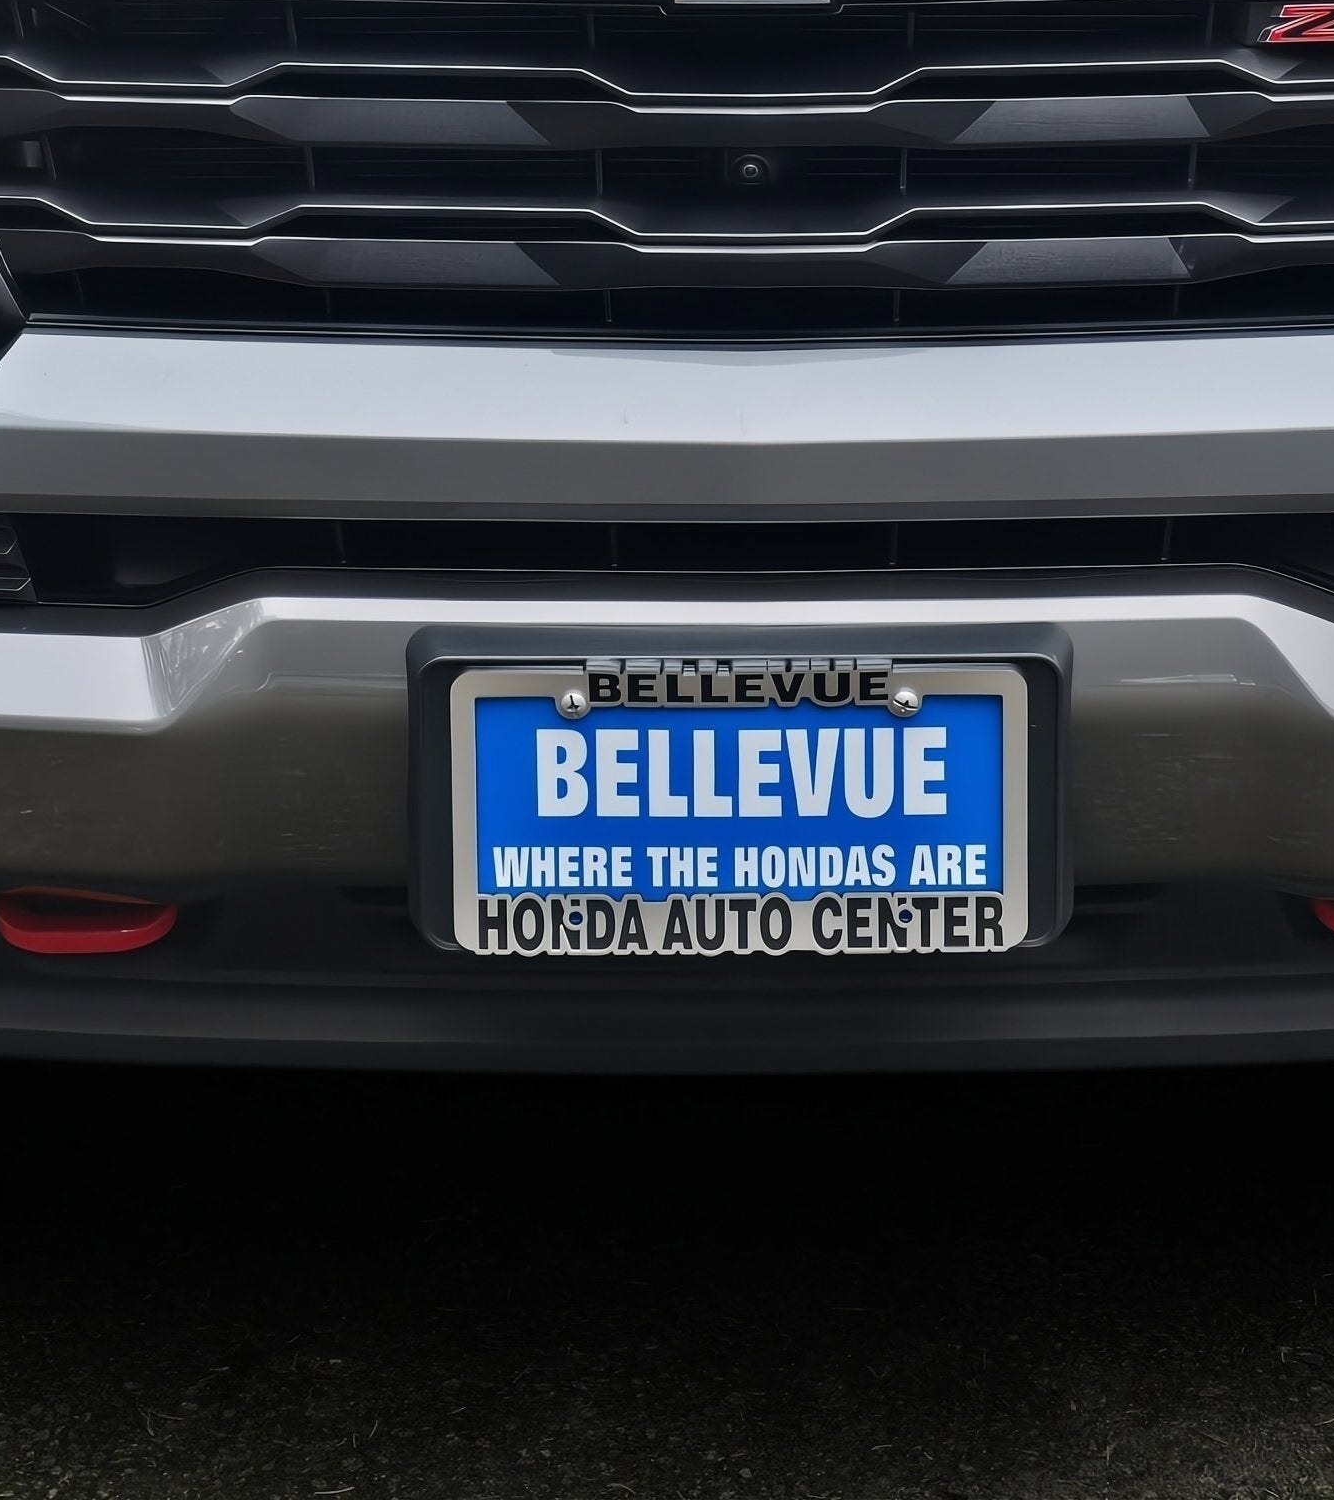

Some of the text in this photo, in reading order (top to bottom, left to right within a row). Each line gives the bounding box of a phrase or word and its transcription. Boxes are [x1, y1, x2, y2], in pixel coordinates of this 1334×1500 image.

[588, 670, 890, 704] BELLEVUE
[536, 726, 947, 818] BELLEVUE
[492, 844, 987, 888] WHERE THE HONDAS ARE
[478, 897, 1005, 950] HONDA AUTO CENTER
